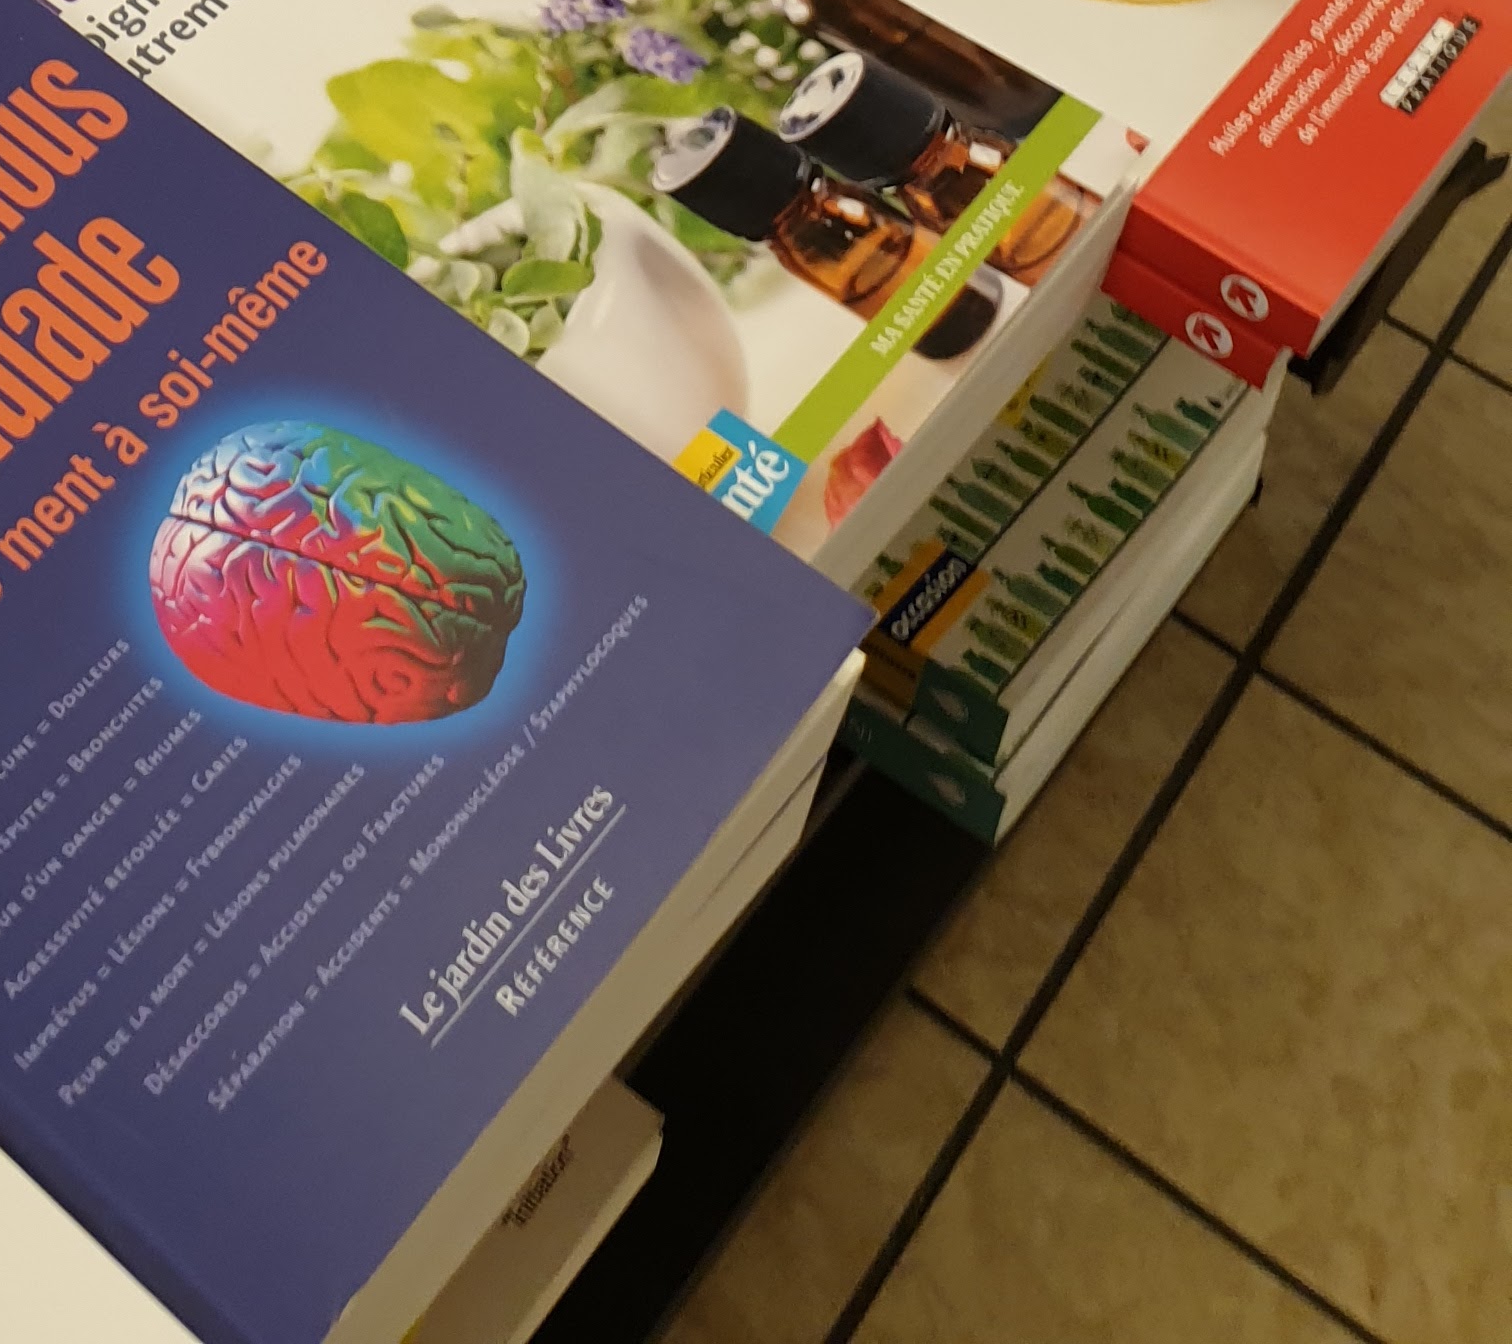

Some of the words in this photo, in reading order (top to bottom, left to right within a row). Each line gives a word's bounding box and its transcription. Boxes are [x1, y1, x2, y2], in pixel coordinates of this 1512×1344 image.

[135, 237, 330, 431] soi-même
[892, 271, 946, 335] SANTÉ
[955, 177, 1027, 259] PRATIQUE
[396, 980, 445, 1040] Le
[436, 907, 514, 1009] jardin
[501, 865, 553, 921] des
[538, 779, 617, 878] Livres
[491, 874, 618, 1021] RÉFÉRENCE
